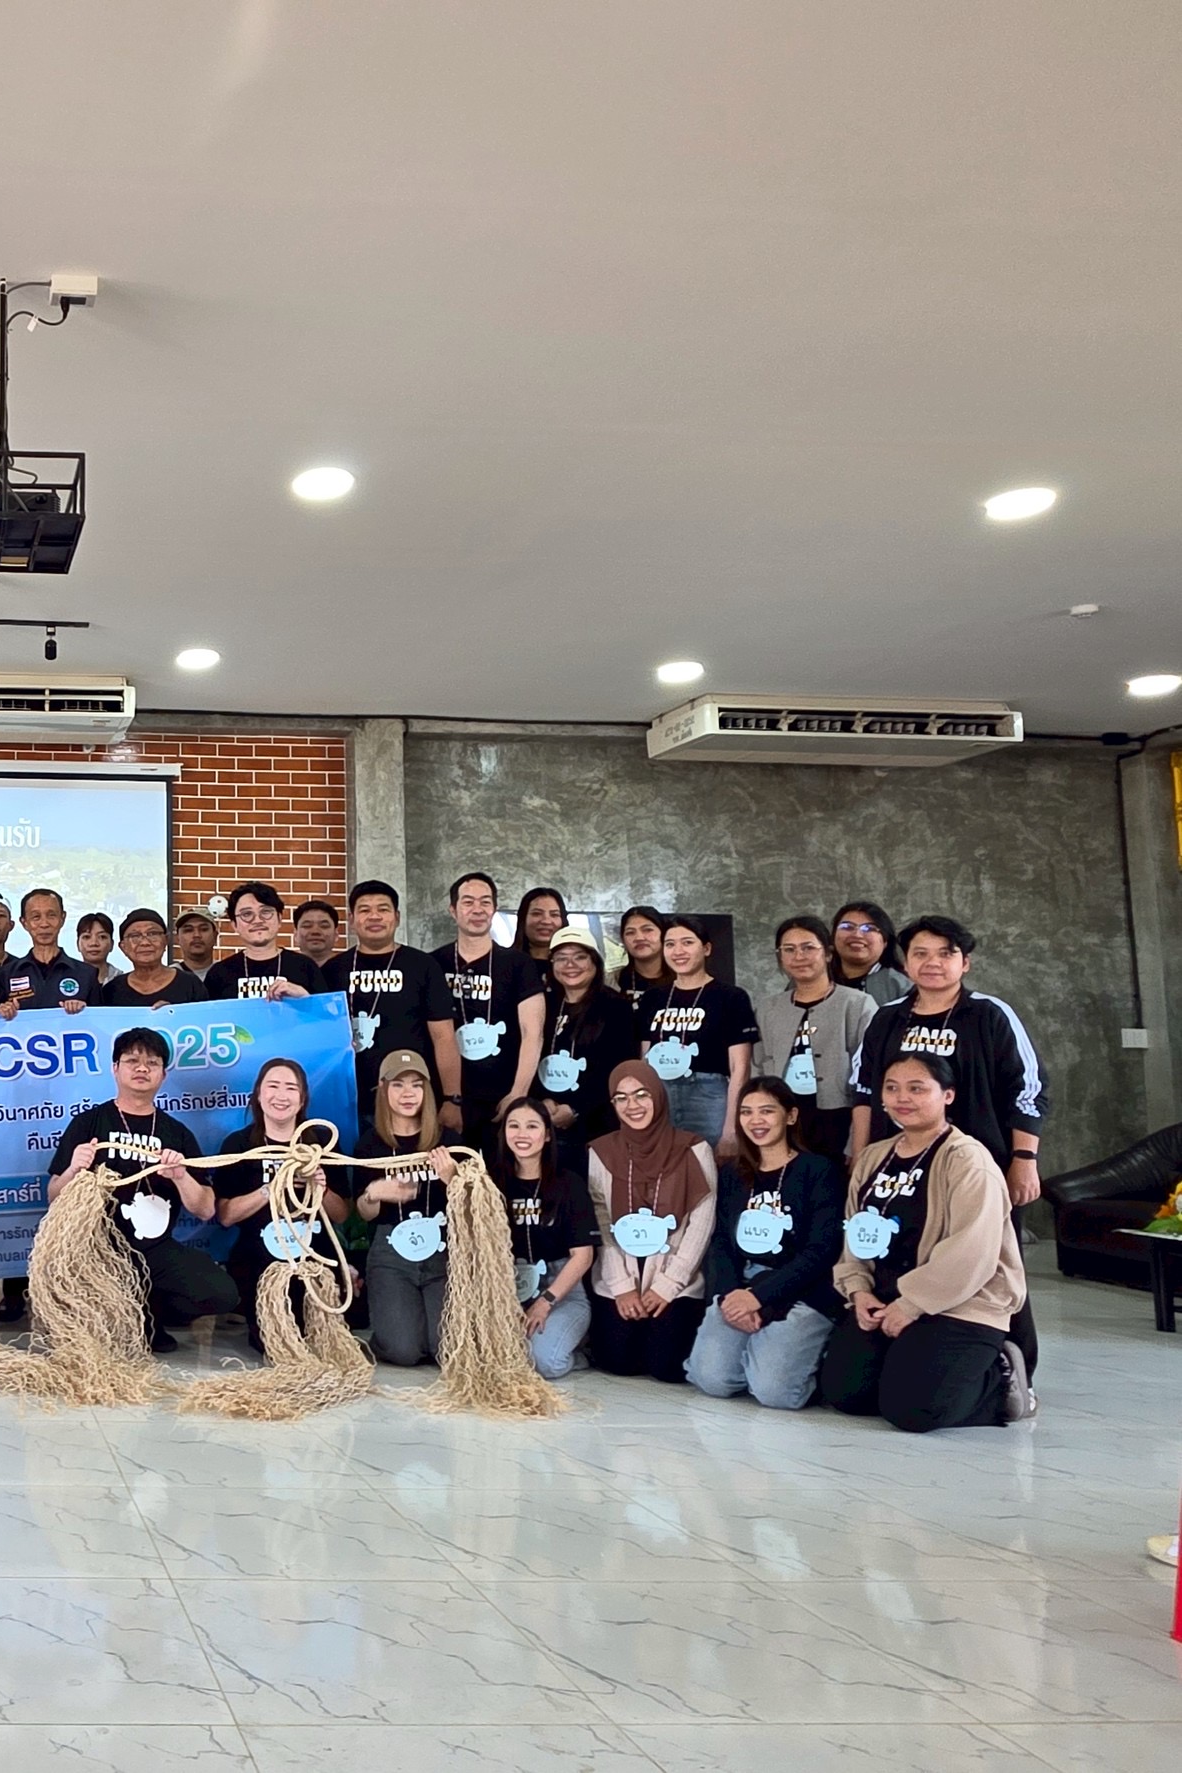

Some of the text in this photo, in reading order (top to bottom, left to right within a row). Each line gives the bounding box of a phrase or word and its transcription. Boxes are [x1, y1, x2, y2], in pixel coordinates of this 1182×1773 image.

[238, 976, 287, 999] FUN
[349, 970, 404, 994] FUND
[650, 1007, 705, 1032] FUND
[153, 1025, 240, 1069] 25
